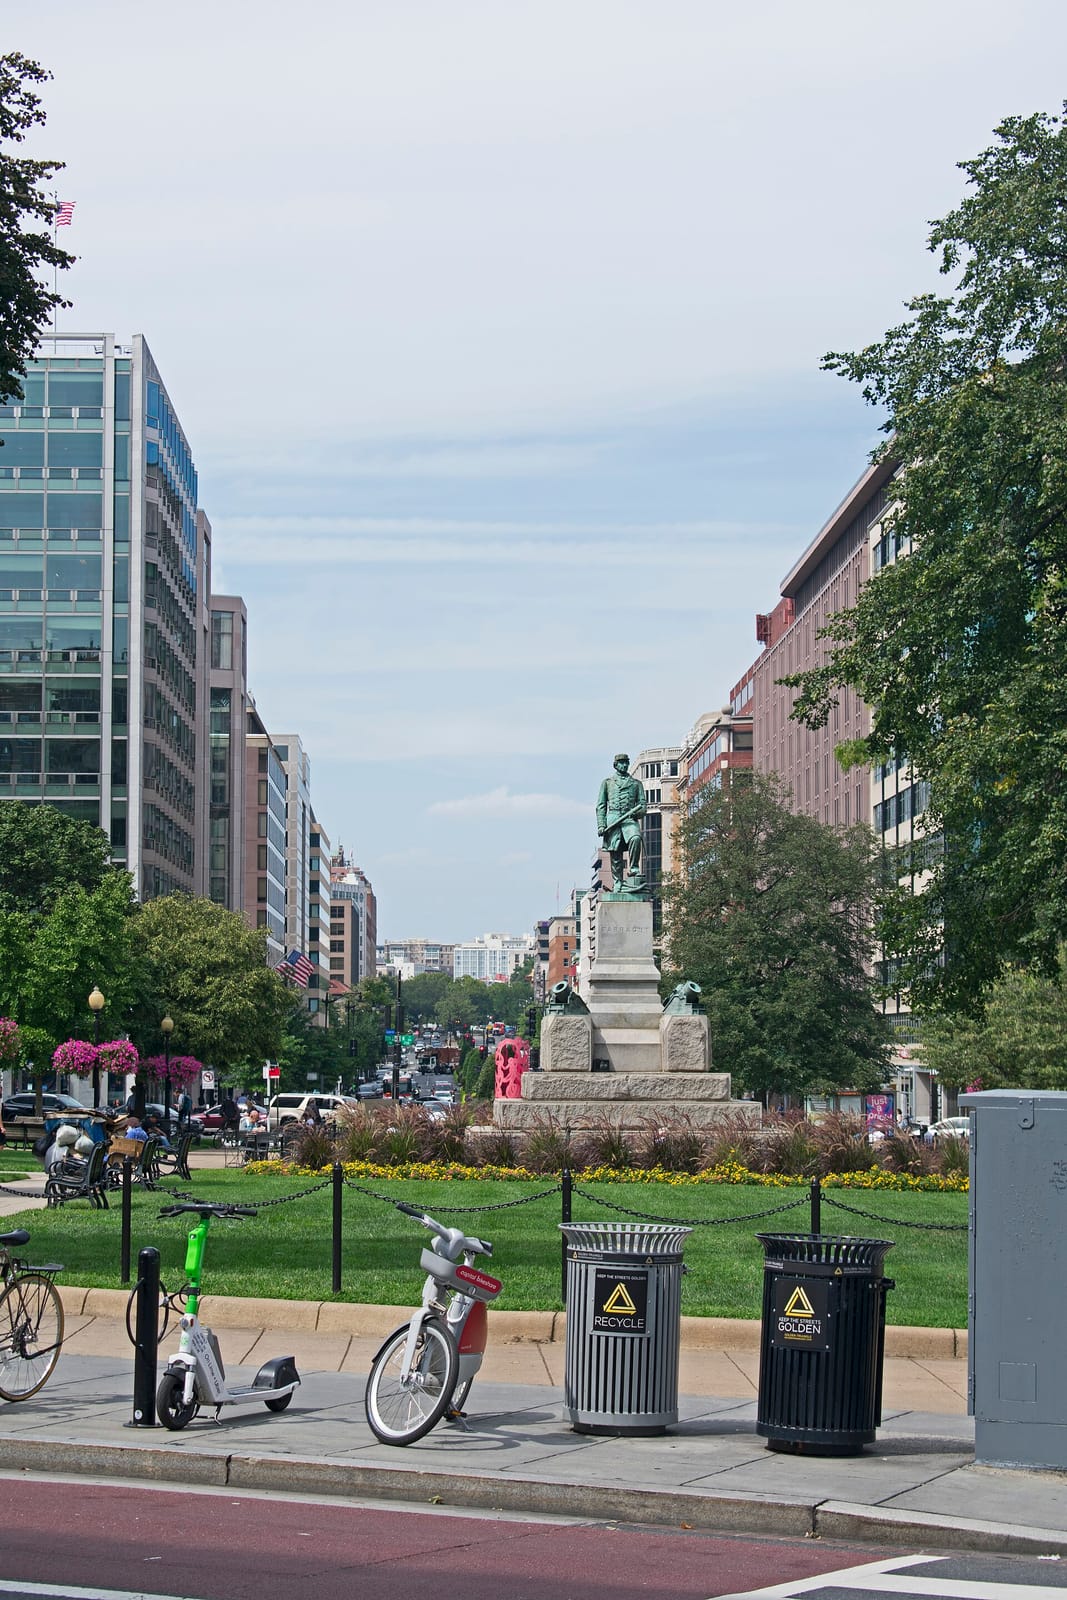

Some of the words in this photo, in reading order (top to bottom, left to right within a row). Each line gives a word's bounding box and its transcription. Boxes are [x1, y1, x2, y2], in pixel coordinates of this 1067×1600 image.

[871, 1095, 888, 1106] just
[460, 1270, 476, 1280] capital
[477, 1276, 496, 1289] bikeshare
[594, 1316, 644, 1328] RECYCLE
[778, 1322, 821, 1334] GOLDEN
